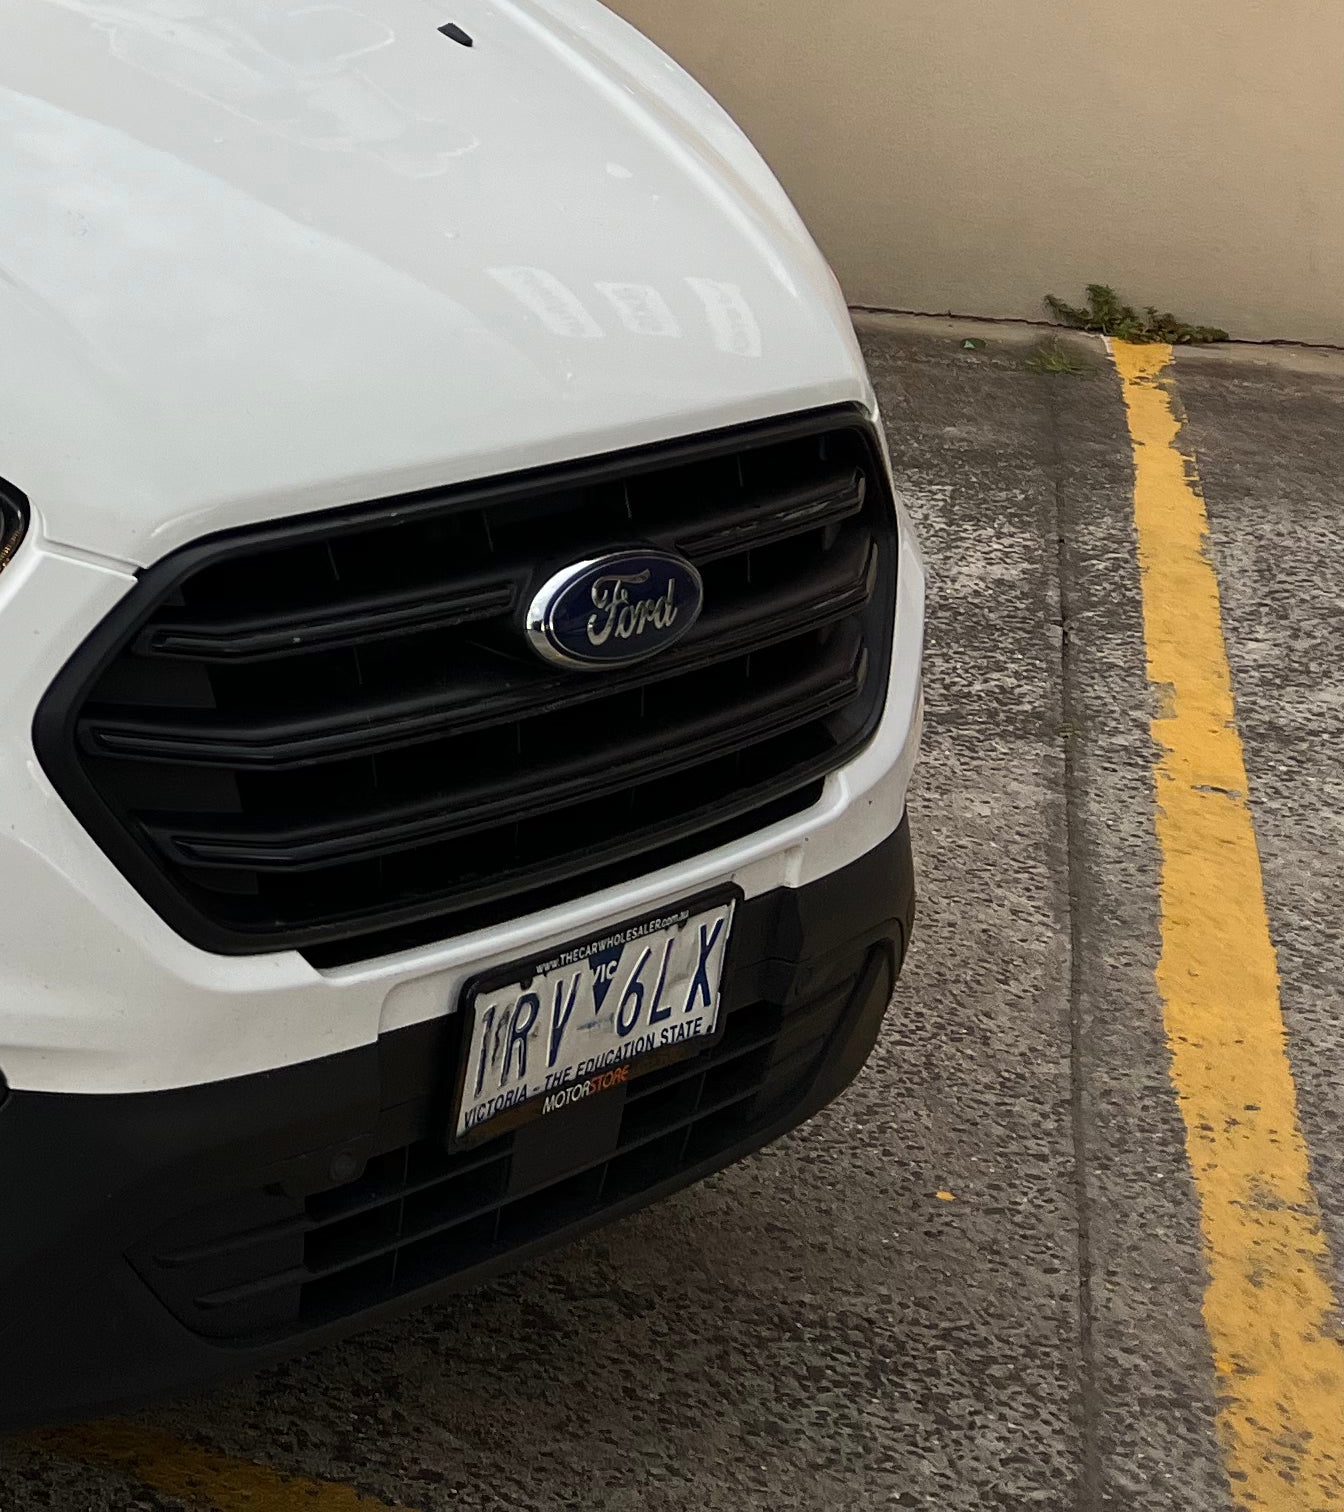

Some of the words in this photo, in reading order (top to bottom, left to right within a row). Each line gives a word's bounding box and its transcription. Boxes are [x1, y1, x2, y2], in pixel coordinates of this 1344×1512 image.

[586, 568, 679, 646] Ford
[593, 959, 619, 985] VIC
[464, 1084, 528, 1130] VICTORIA
[544, 1067, 572, 1092] THE
[576, 1035, 656, 1078] EDUCATION
[659, 1017, 704, 1045] STATE
